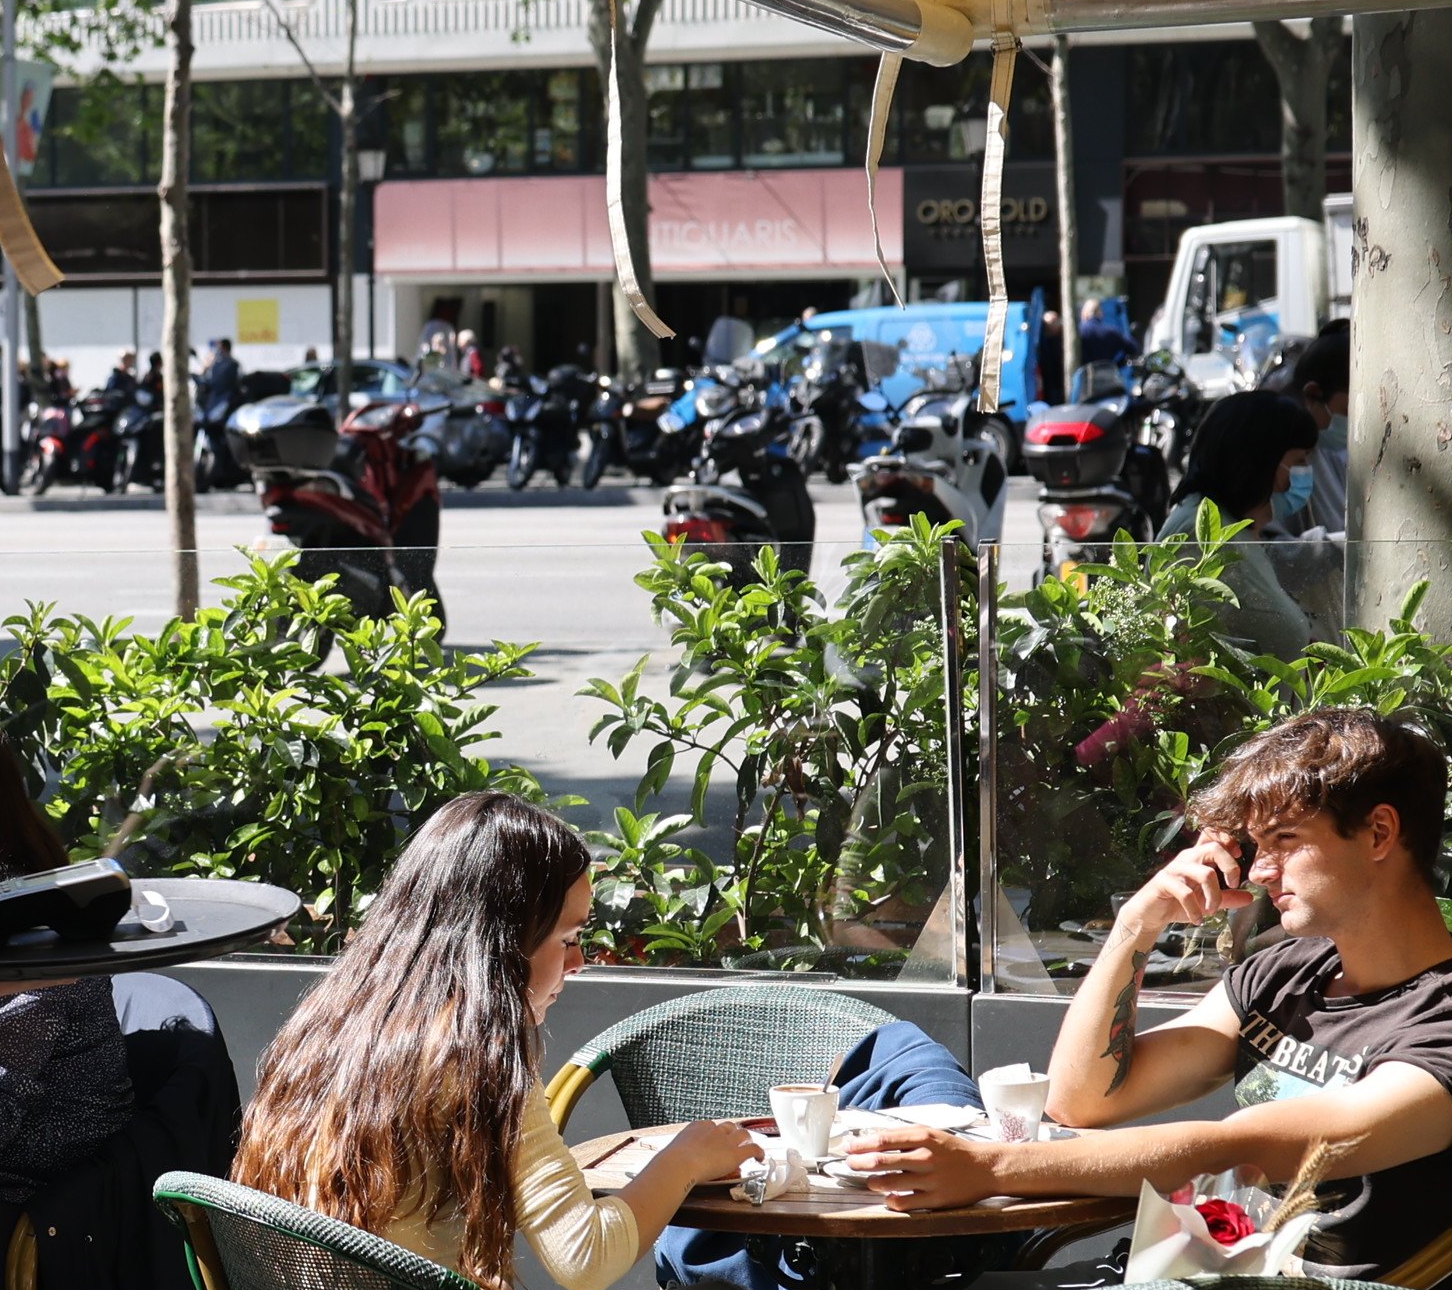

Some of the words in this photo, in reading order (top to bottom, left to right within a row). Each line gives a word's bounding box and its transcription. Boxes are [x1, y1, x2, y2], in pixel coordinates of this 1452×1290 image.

[917, 196, 1048, 225] OROOLD
[649, 218, 799, 249] TIQUARIS
[1238, 1009, 1286, 1059] TH
